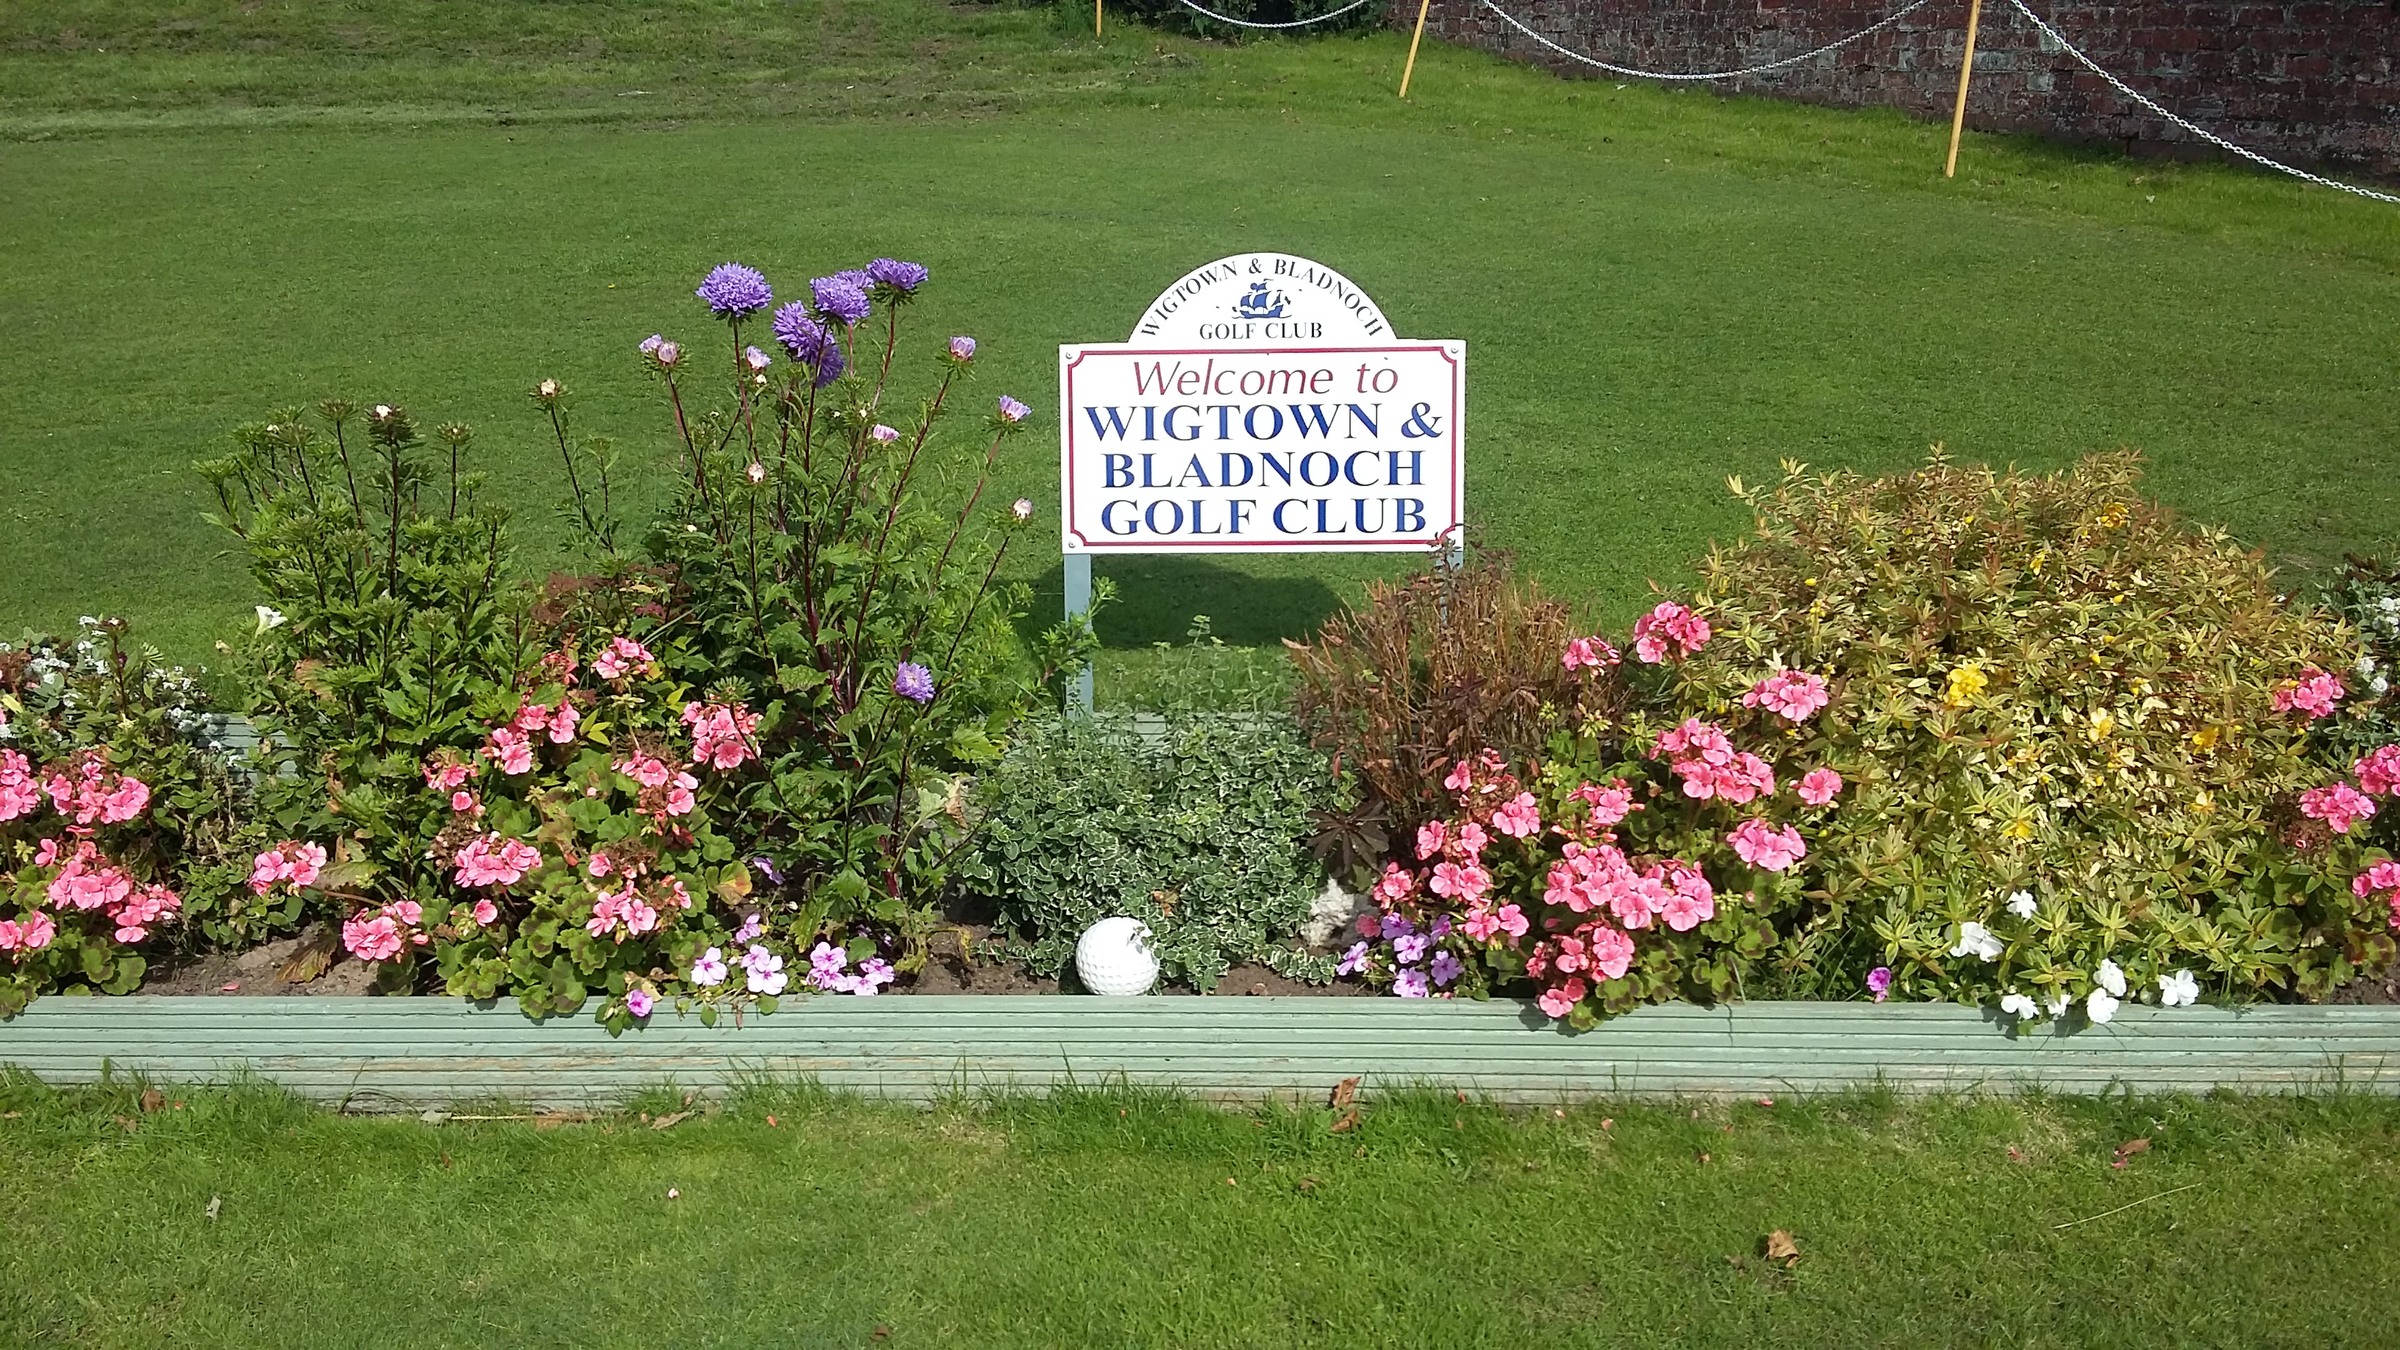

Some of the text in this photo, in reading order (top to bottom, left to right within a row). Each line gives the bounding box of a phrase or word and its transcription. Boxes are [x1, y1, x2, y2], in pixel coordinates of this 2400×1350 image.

[1141, 258, 1383, 338] WIGTOWN & BLADNOCH
[1199, 322, 1322, 340] GOLF CLUB
[1134, 359, 1398, 396] Welcome to
[1084, 402, 1443, 441] WIGTOWN &
[1101, 450, 1425, 488] BLADNOCH
[1101, 498, 1426, 535] GOLF CLUB
